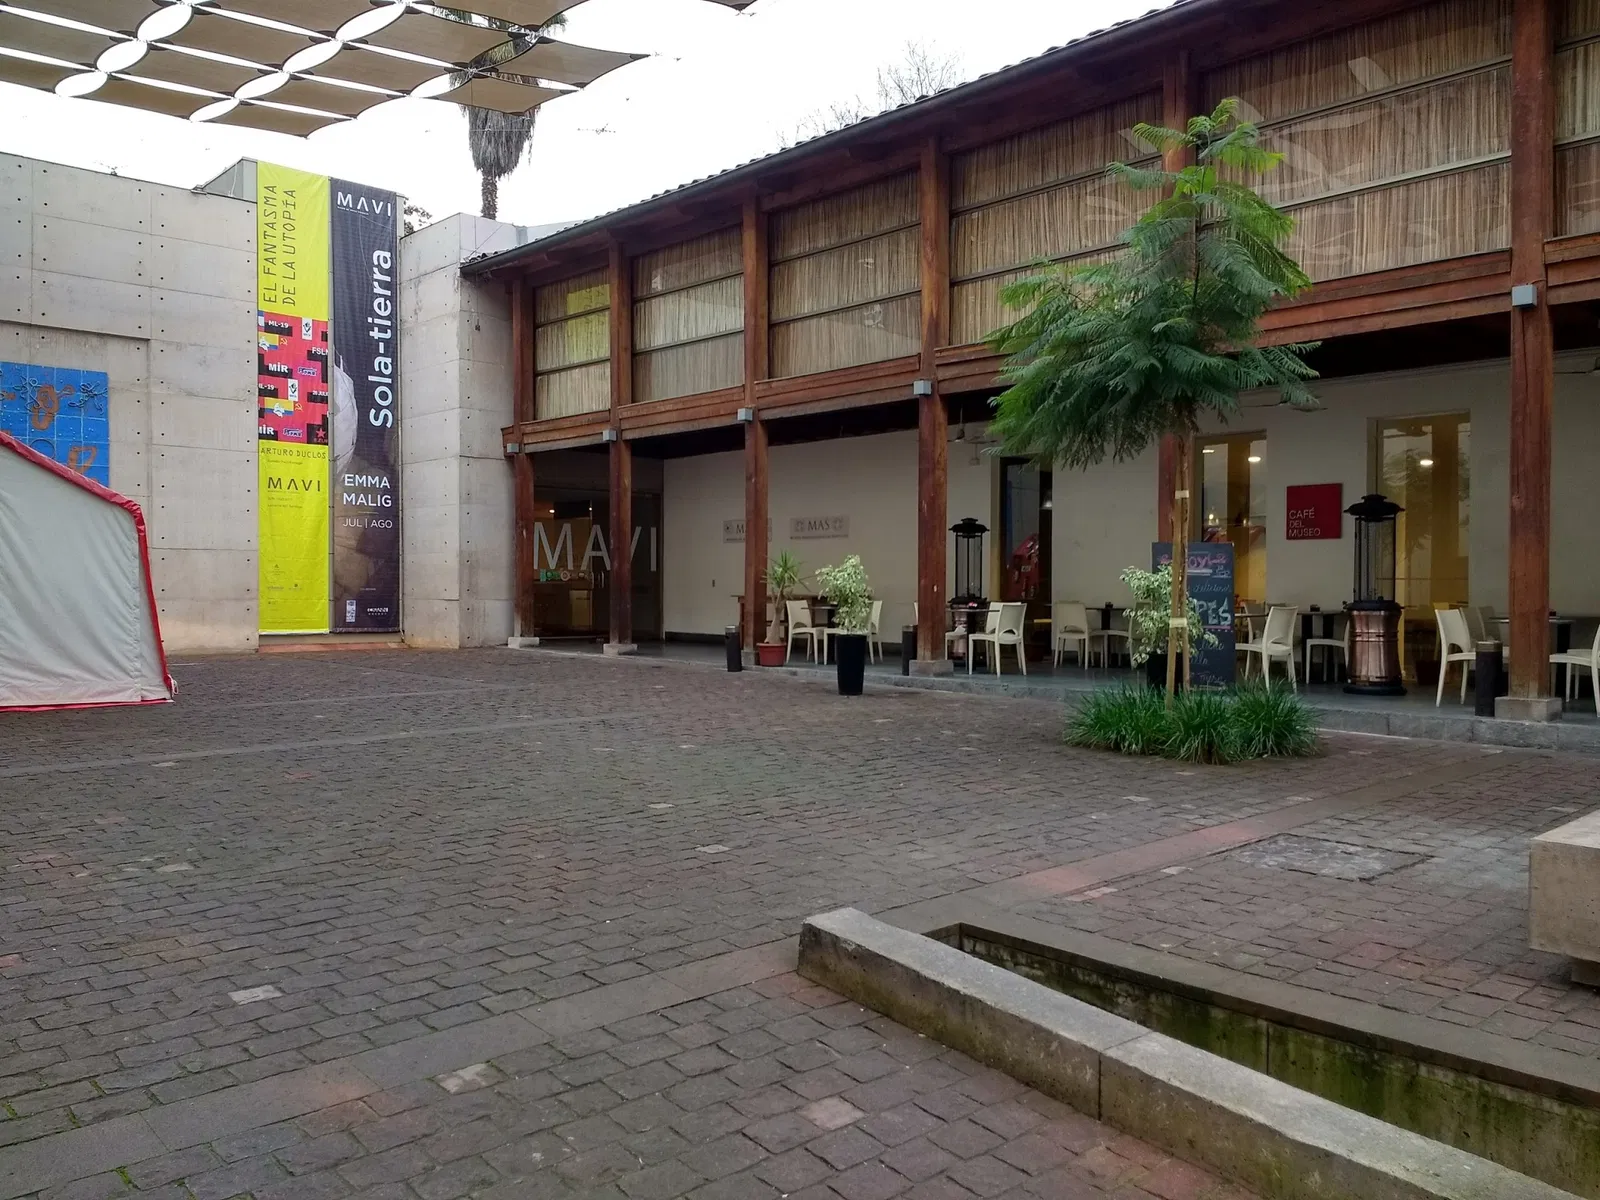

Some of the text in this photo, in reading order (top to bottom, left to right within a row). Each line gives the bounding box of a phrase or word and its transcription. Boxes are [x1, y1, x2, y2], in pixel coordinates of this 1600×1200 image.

[337, 191, 391, 217] MAVI
[263, 185, 277, 303] EL FANTASMA
[281, 190, 296, 306] DE LA UTOPÍA
[367, 250, 393, 429] Sola-tierra
[260, 447, 327, 460] ARTURO DUCLOS
[267, 476, 321, 492] MAVI
[344, 474, 391, 489] EMMA
[343, 492, 392, 508] MALIG
[1289, 506, 1315, 519] CAFÉ
[342, 518, 364, 528] JUL
[370, 519, 393, 529] AGO
[807, 520, 831, 531] MAS
[1289, 520, 1305, 528] DEL
[1288, 527, 1321, 537] MUSEO
